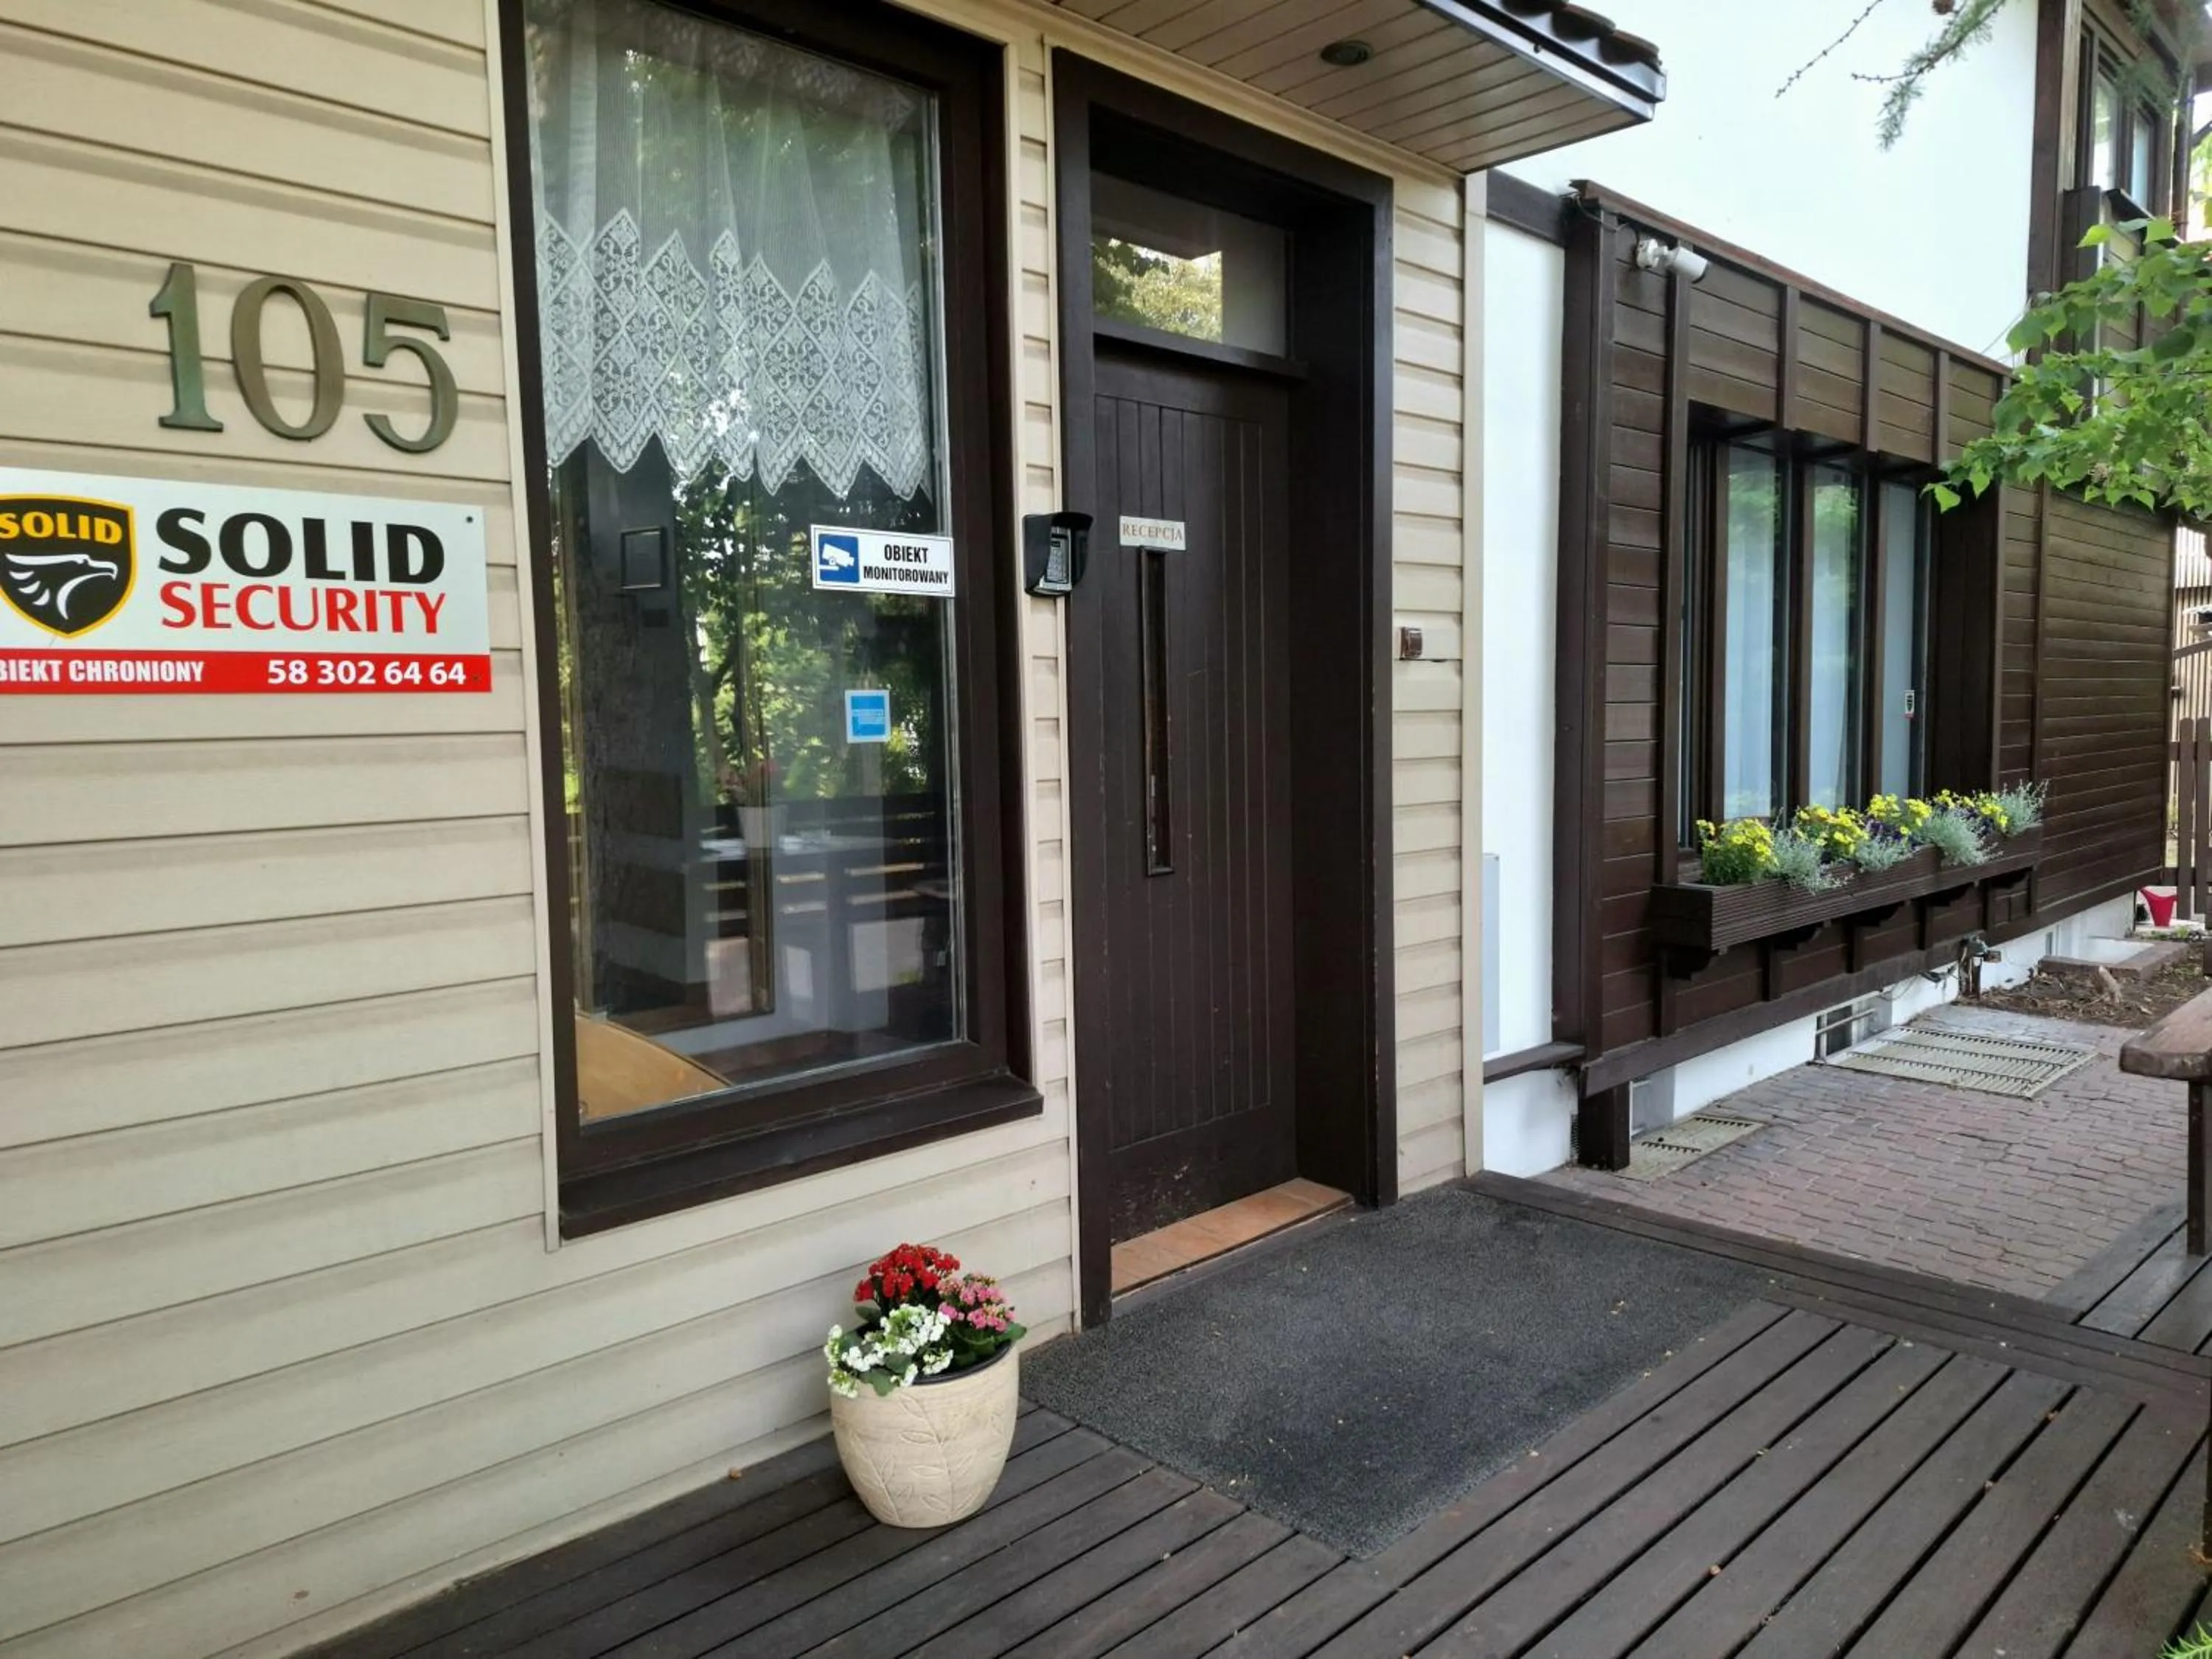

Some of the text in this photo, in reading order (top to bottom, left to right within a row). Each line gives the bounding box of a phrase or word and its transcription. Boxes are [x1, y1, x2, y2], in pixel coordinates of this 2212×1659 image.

[148, 262, 459, 454] 105
[0, 511, 122, 544] SOLID
[1121, 524, 1183, 541] RECEPCJA
[156, 507, 445, 584] SOLID
[884, 544, 929, 563] OBIEKT
[863, 566, 949, 584] MONITOROWANY
[159, 581, 446, 634] SECURITY
[69, 659, 204, 682] CHRONIONY
[268, 660, 467, 684] 58 302 64 64
